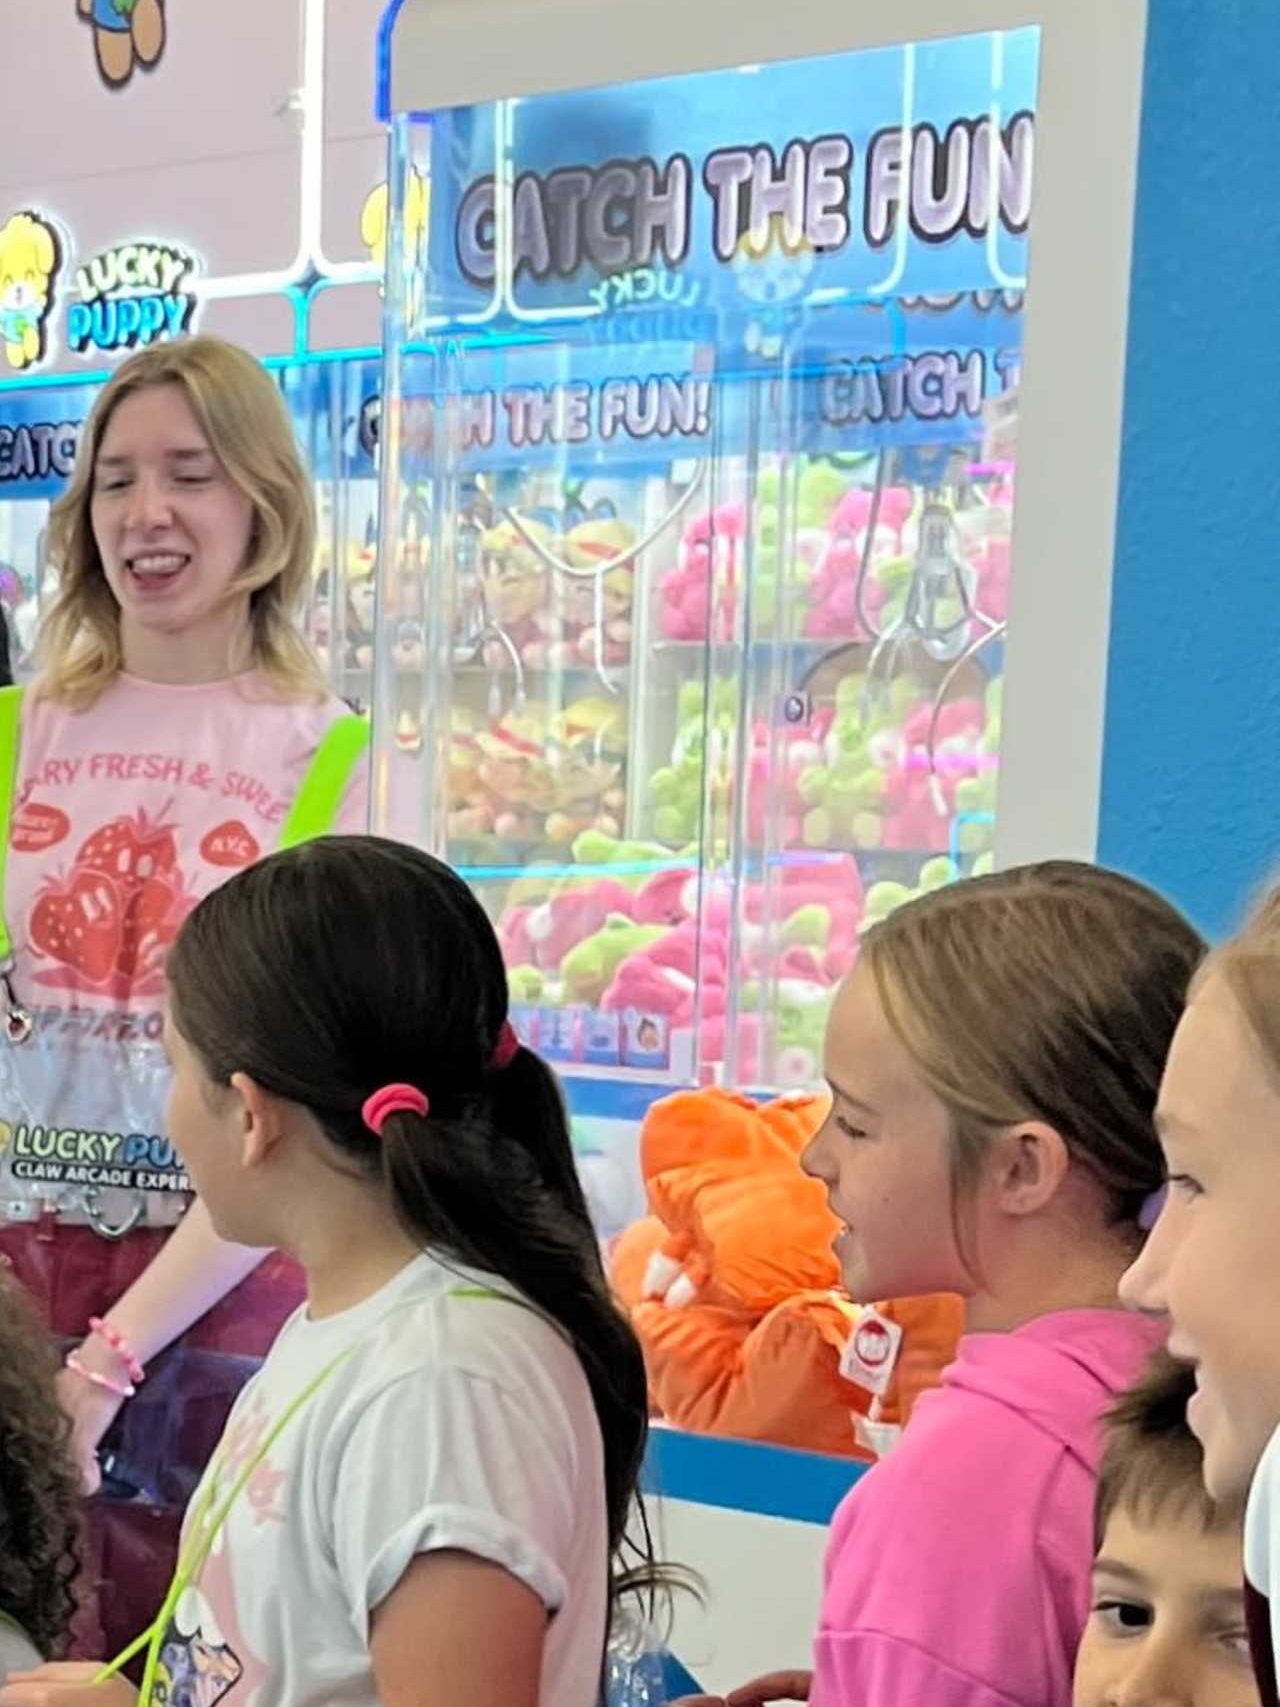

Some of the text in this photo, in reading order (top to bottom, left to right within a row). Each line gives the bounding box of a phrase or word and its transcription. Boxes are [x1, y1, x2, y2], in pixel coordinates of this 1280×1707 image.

[456, 154, 692, 288] CATCH
[703, 136, 854, 262] THE
[74, 243, 192, 299] LUCKY
[66, 292, 197, 353] PUPPY
[501, 381, 591, 448] THE
[598, 370, 713, 443] FUN!
[823, 347, 986, 424] CATCH
[91, 753, 183, 784] FRESH
[187, 761, 215, 791] &
[220, 770, 287, 824] SWEE
[14, 1124, 123, 1165] LUCKY
[15, 1163, 193, 1192] CLAW ARCADE EXPER
